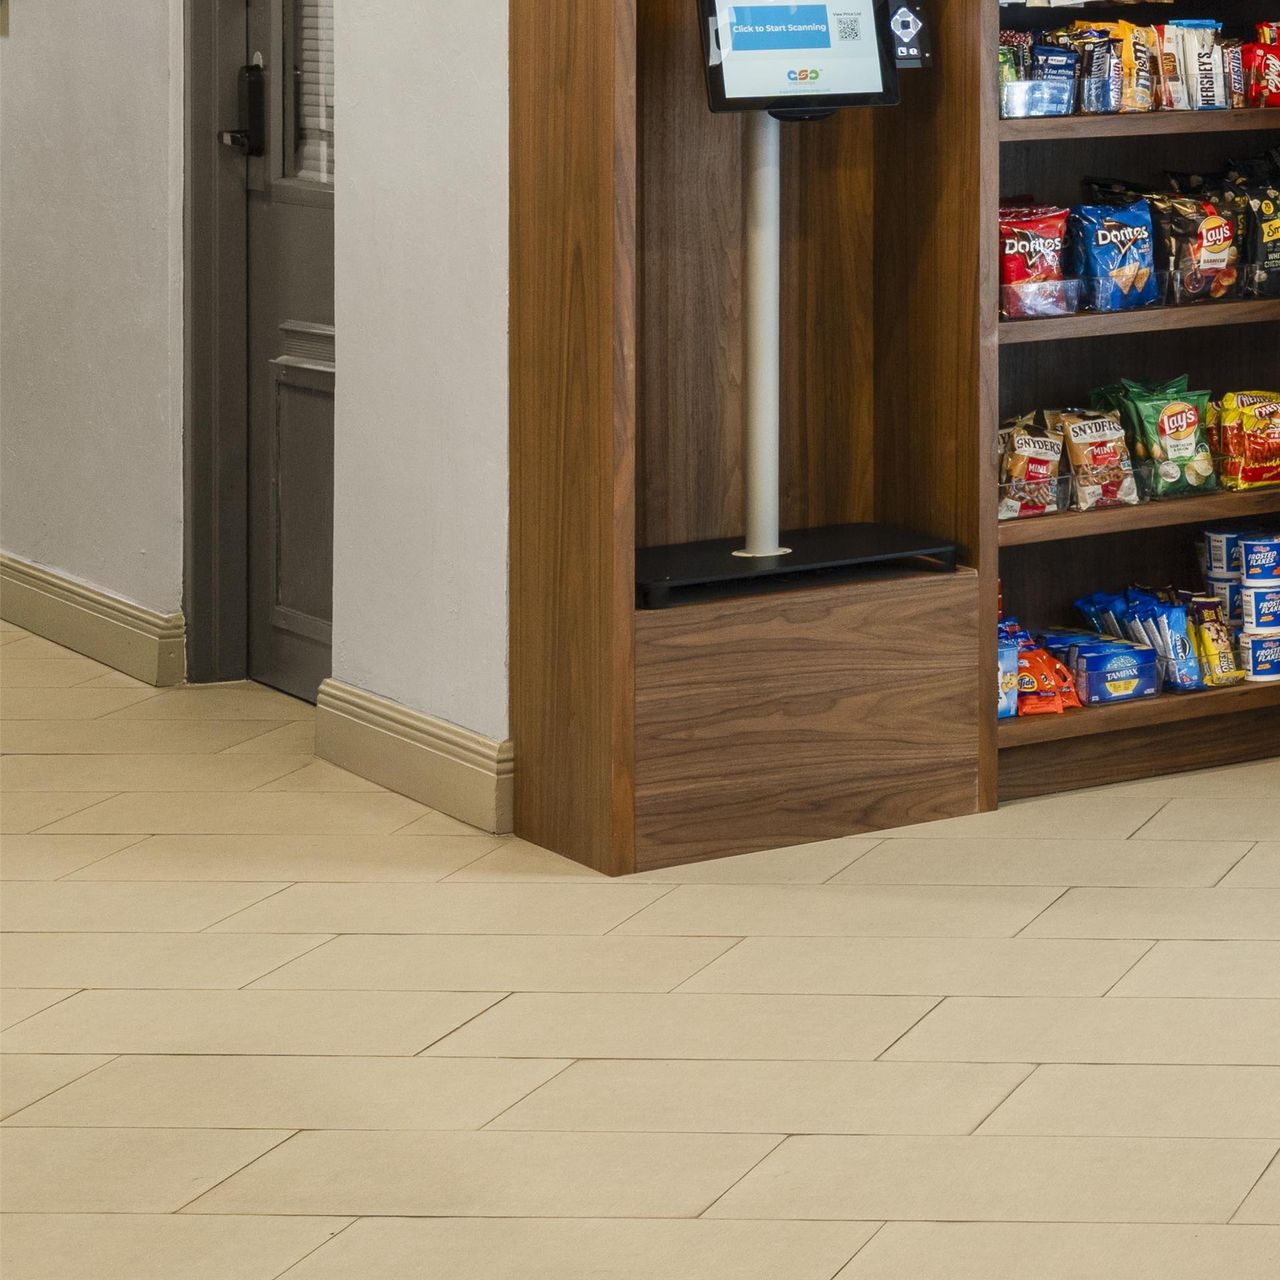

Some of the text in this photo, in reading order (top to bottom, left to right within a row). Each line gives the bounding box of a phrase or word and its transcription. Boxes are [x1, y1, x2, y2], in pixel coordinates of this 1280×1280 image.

[733, 22, 827, 33] Click to Start Scanning
[1198, 50, 1215, 106] HERSHEY'S
[1096, 225, 1149, 246] Doritos
[1201, 224, 1233, 247] Lay's
[1004, 236, 1062, 256] Doritos
[1163, 409, 1196, 435] Lay's
[1016, 436, 1062, 455] SNYDER'S
[1028, 462, 1047, 474] MINI
[1248, 551, 1277, 561] FROSTED
[1249, 556, 1274, 566] FLAKES
[1019, 677, 1035, 687] Tide
[1106, 668, 1139, 681] TAMPAX
